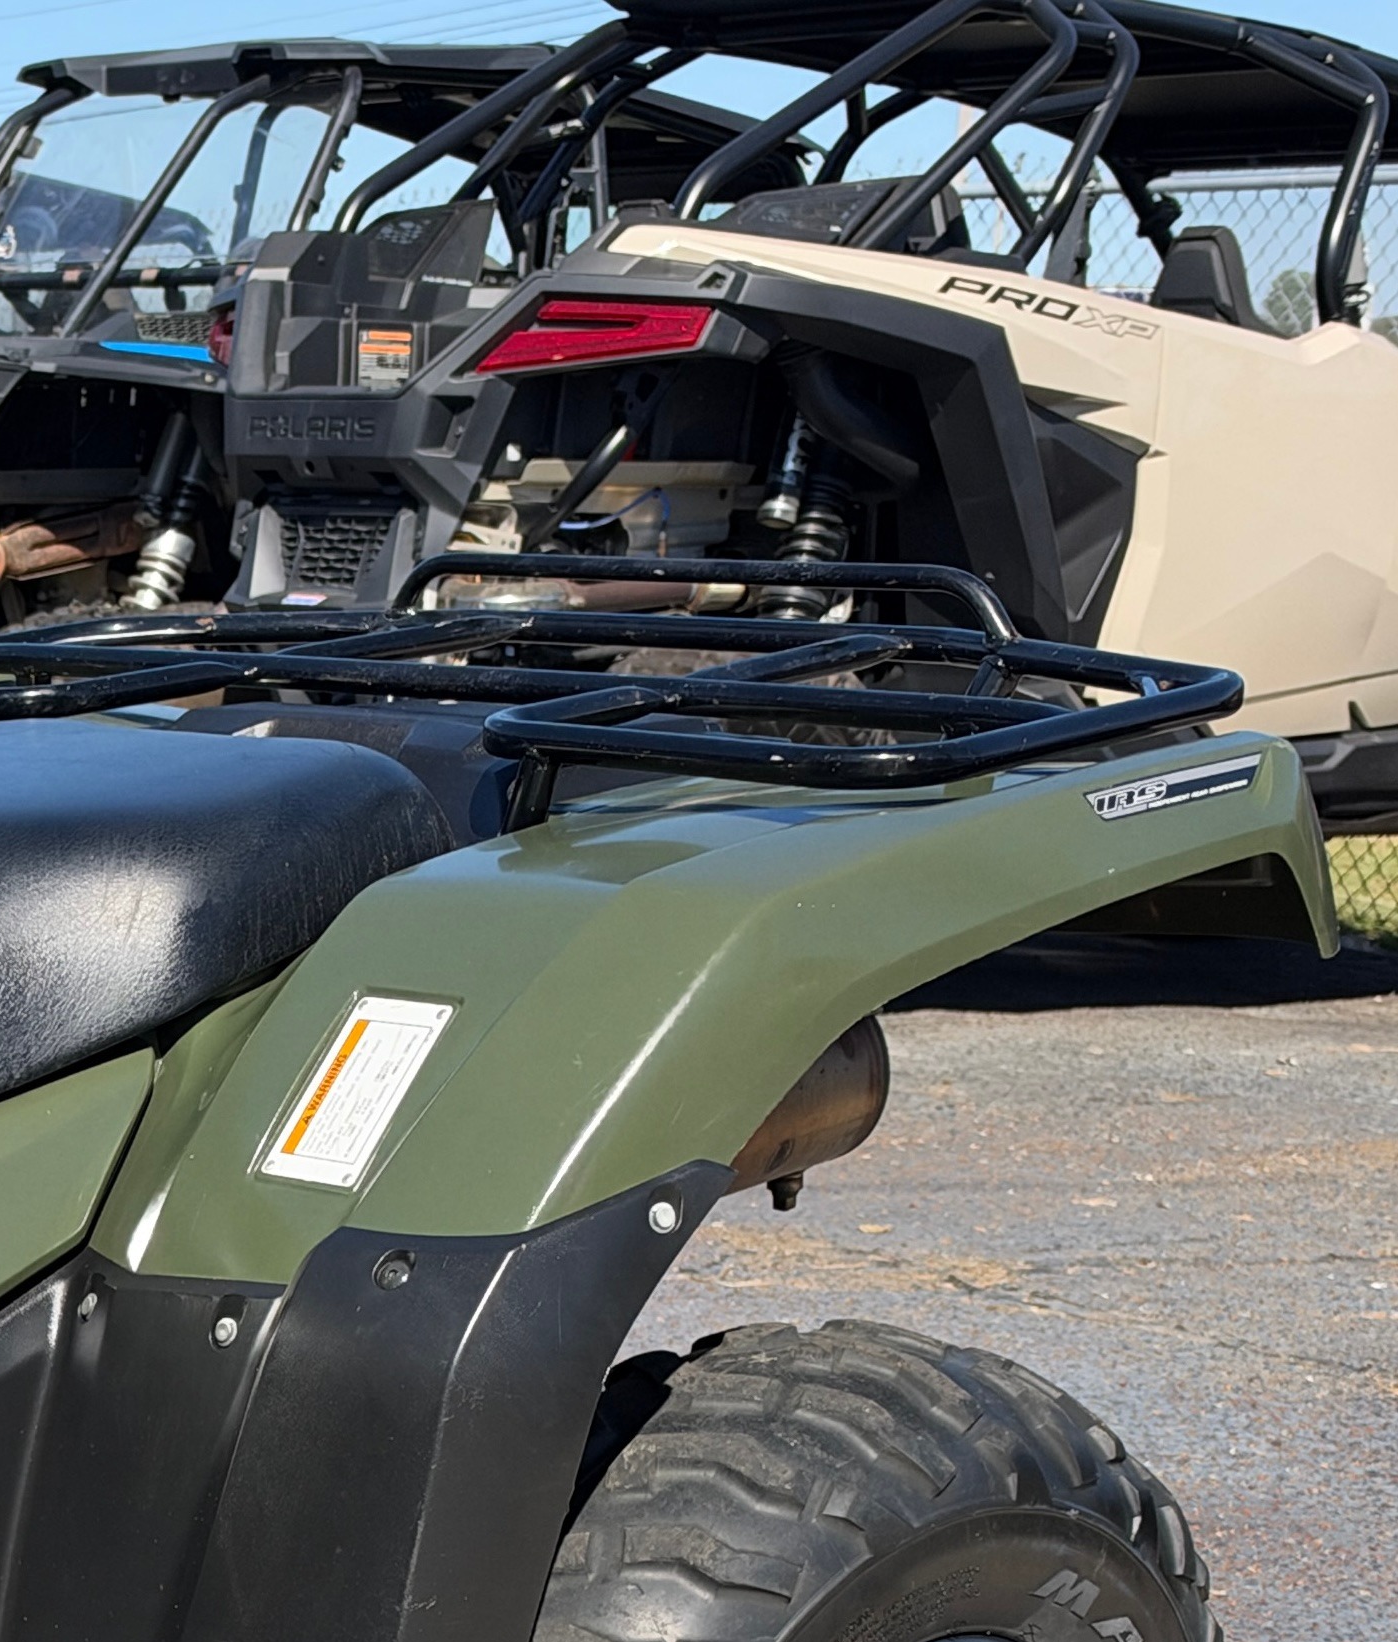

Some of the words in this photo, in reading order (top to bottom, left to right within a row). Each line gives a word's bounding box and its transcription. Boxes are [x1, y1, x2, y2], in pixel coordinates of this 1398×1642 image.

[937, 276, 1079, 321] PRO
[246, 414, 375, 442] POLARIS
[307, 1053, 348, 1113] WARNING
